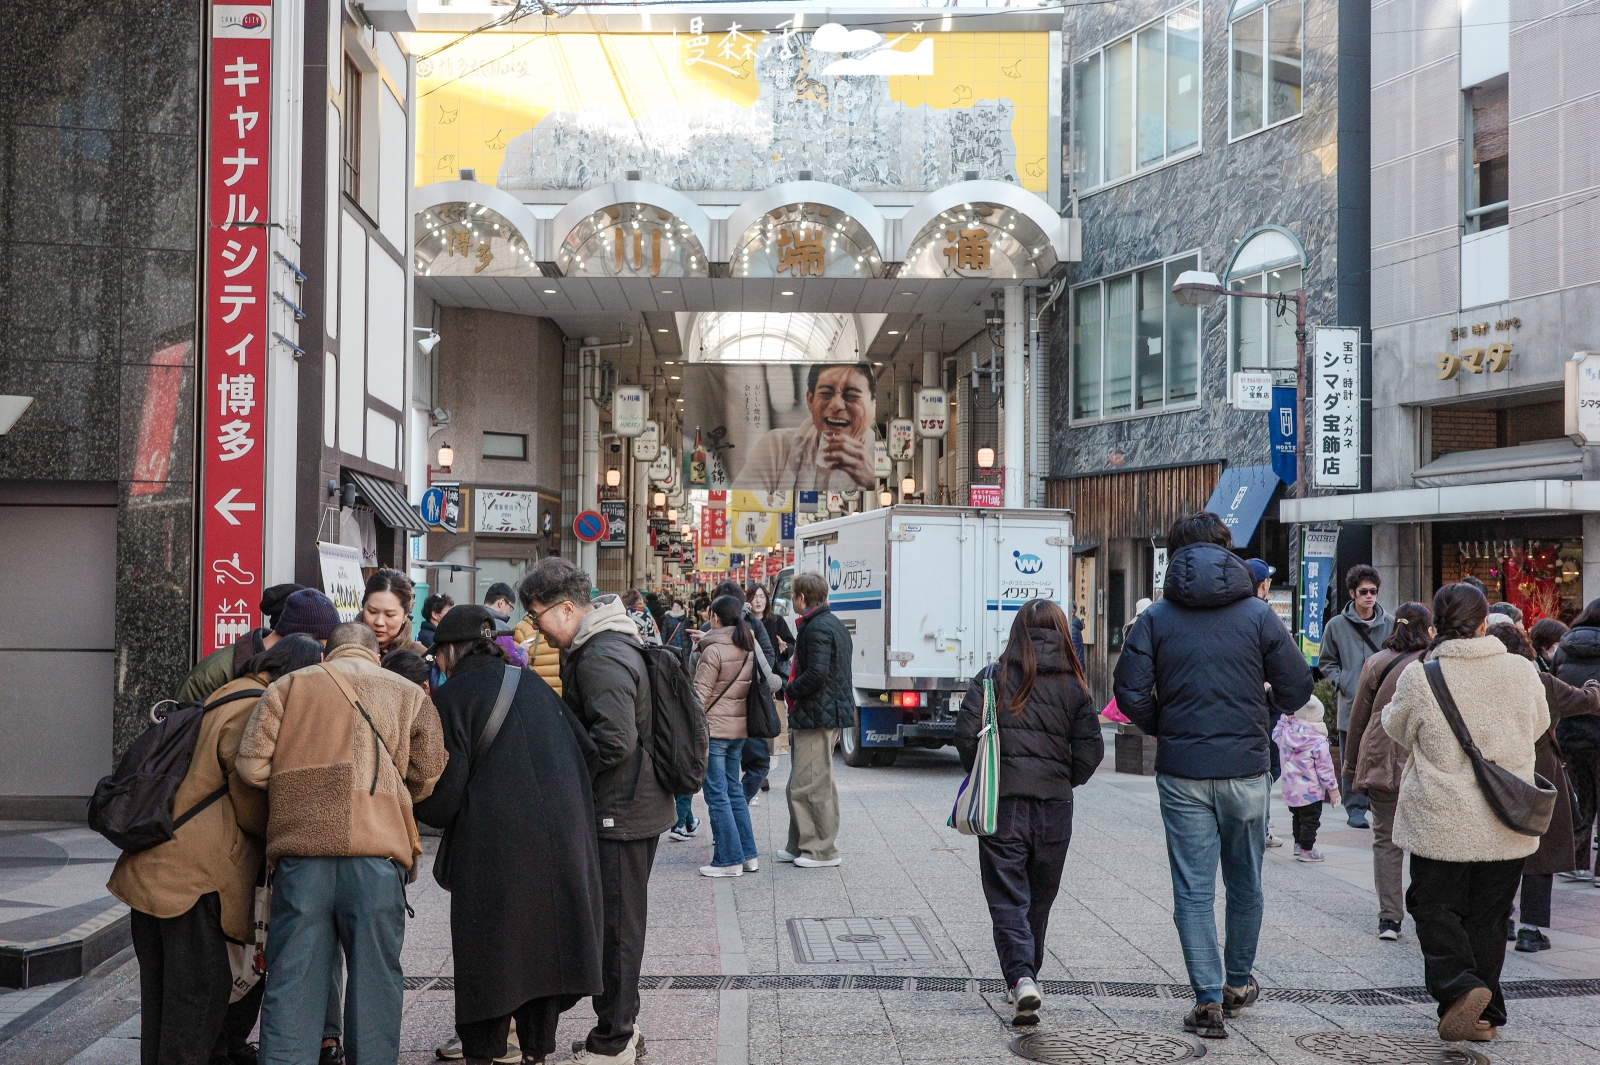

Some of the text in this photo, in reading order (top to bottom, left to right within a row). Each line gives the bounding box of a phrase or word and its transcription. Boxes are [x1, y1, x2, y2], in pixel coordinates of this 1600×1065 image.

[244, 16, 260, 24] CITY
[217, 56, 260, 462] キャナルシティ博多
[448, 227, 992, 278] 博多 川 端 通
[1451, 326, 1468, 342] 宝石
[1472, 322, 1490, 336] 時計
[1436, 342, 1513, 381] シマダ
[1586, 367, 1600, 380] 博多
[1322, 351, 1341, 475] シマダ宝飾店
[1343, 341, 1353, 449] 宝石・時計・メガネ
[865, 730, 899, 743] Topre
